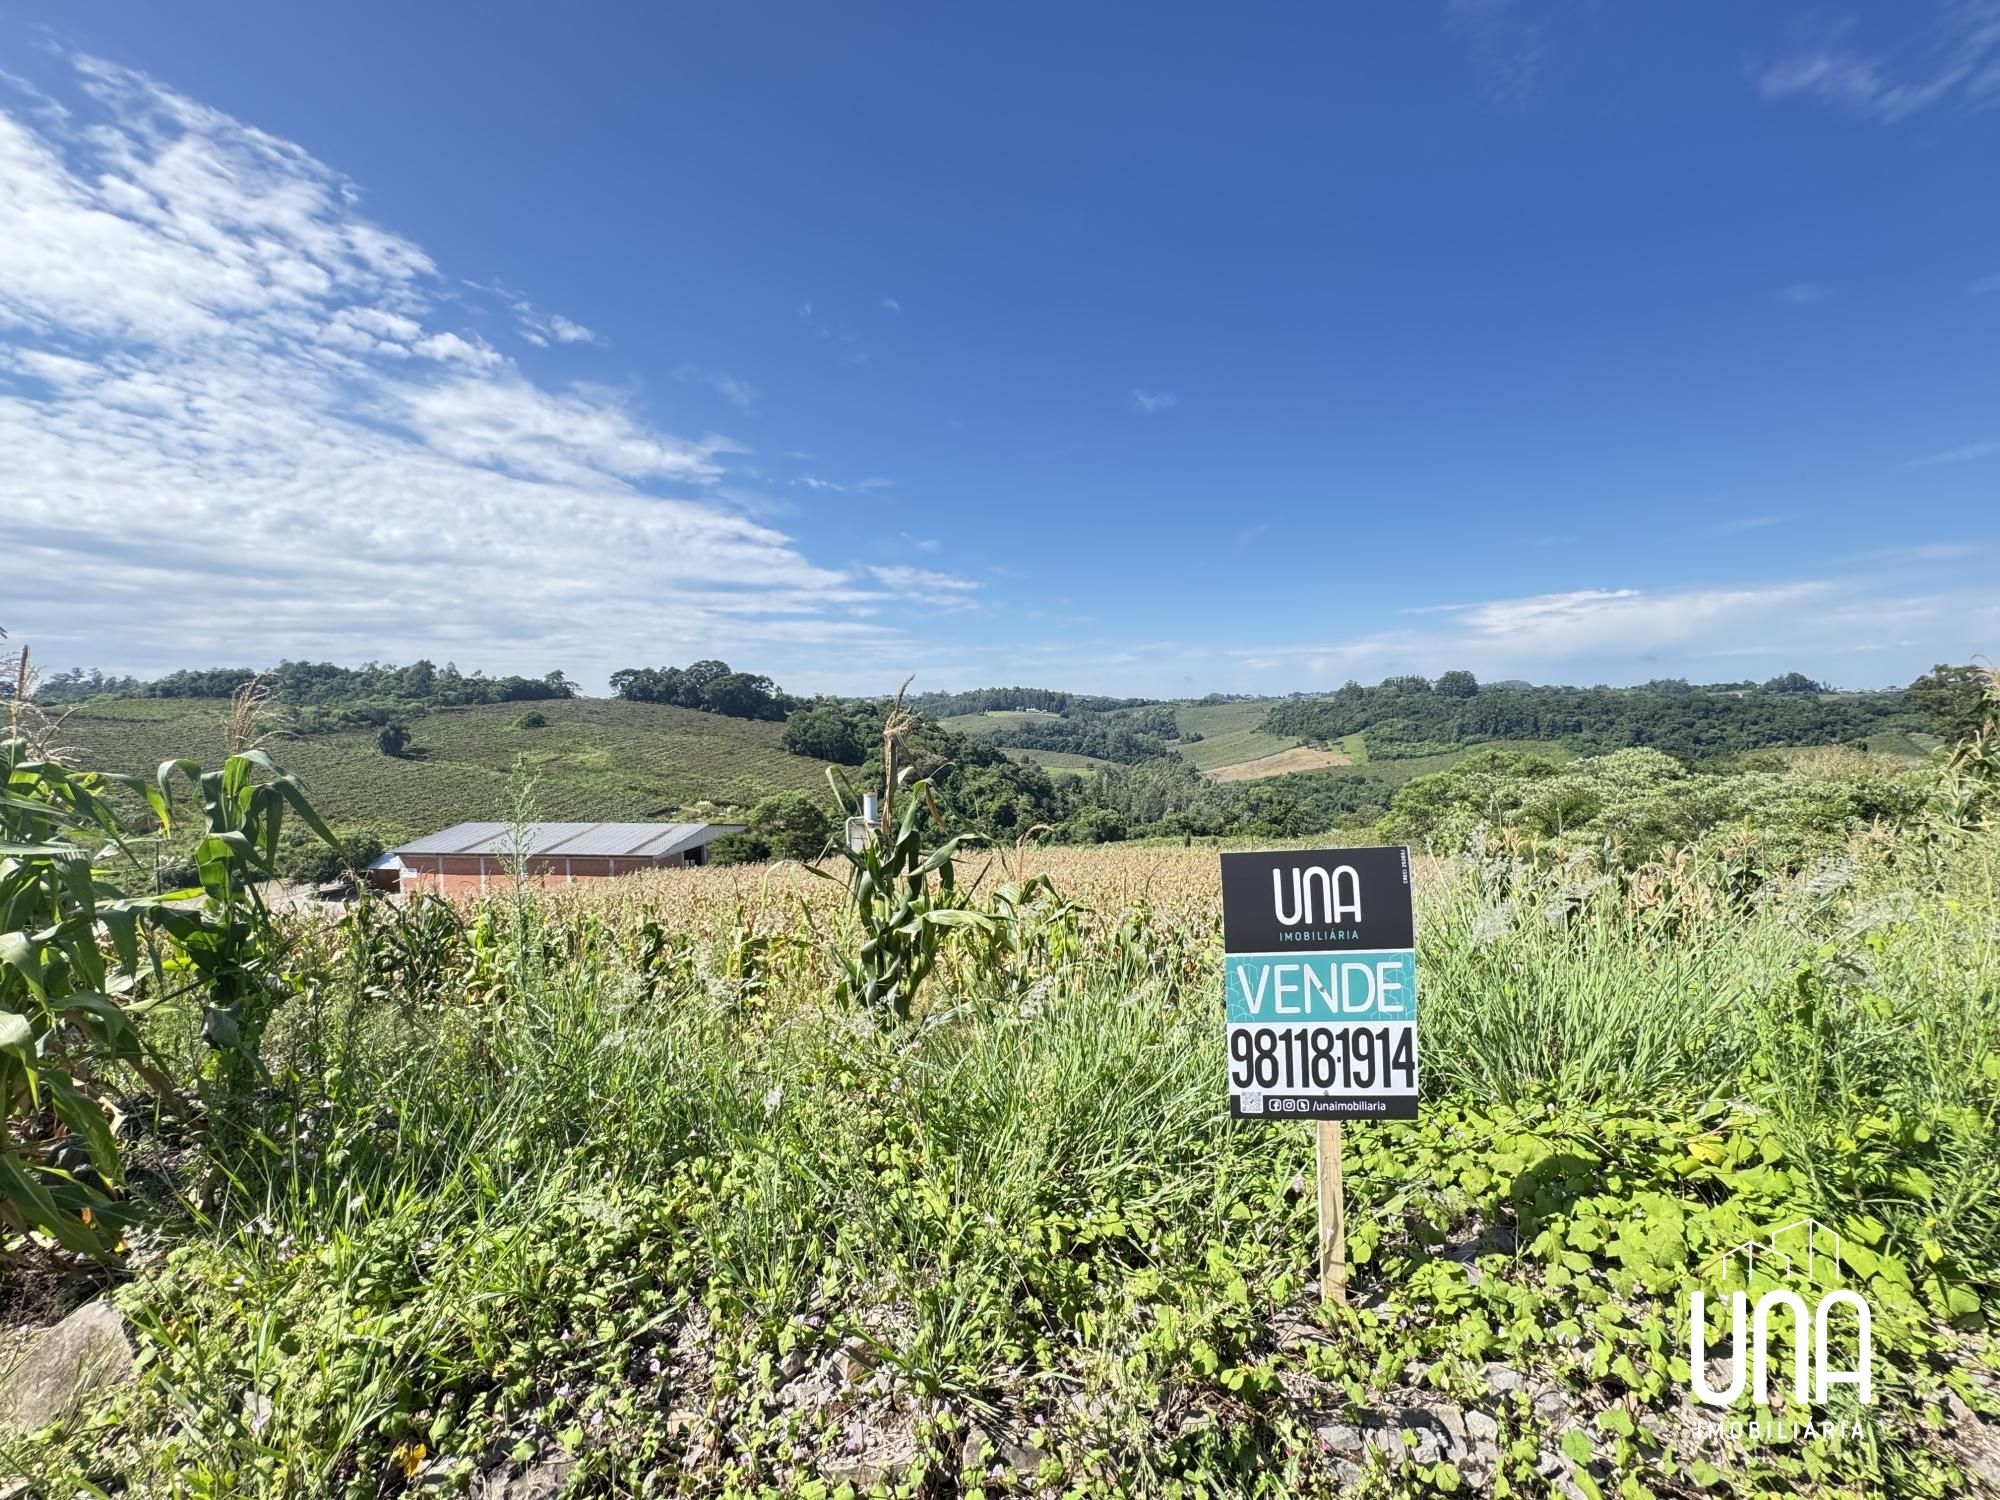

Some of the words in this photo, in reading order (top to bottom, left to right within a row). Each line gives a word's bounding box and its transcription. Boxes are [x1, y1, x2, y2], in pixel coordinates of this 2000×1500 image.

[1272, 865, 1362, 926] UNA
[1279, 927, 1360, 942] IMOBILIÁRIA
[1236, 961, 1404, 1015] VENDE
[1312, 1100, 1387, 1113] /unaimobiliaria
